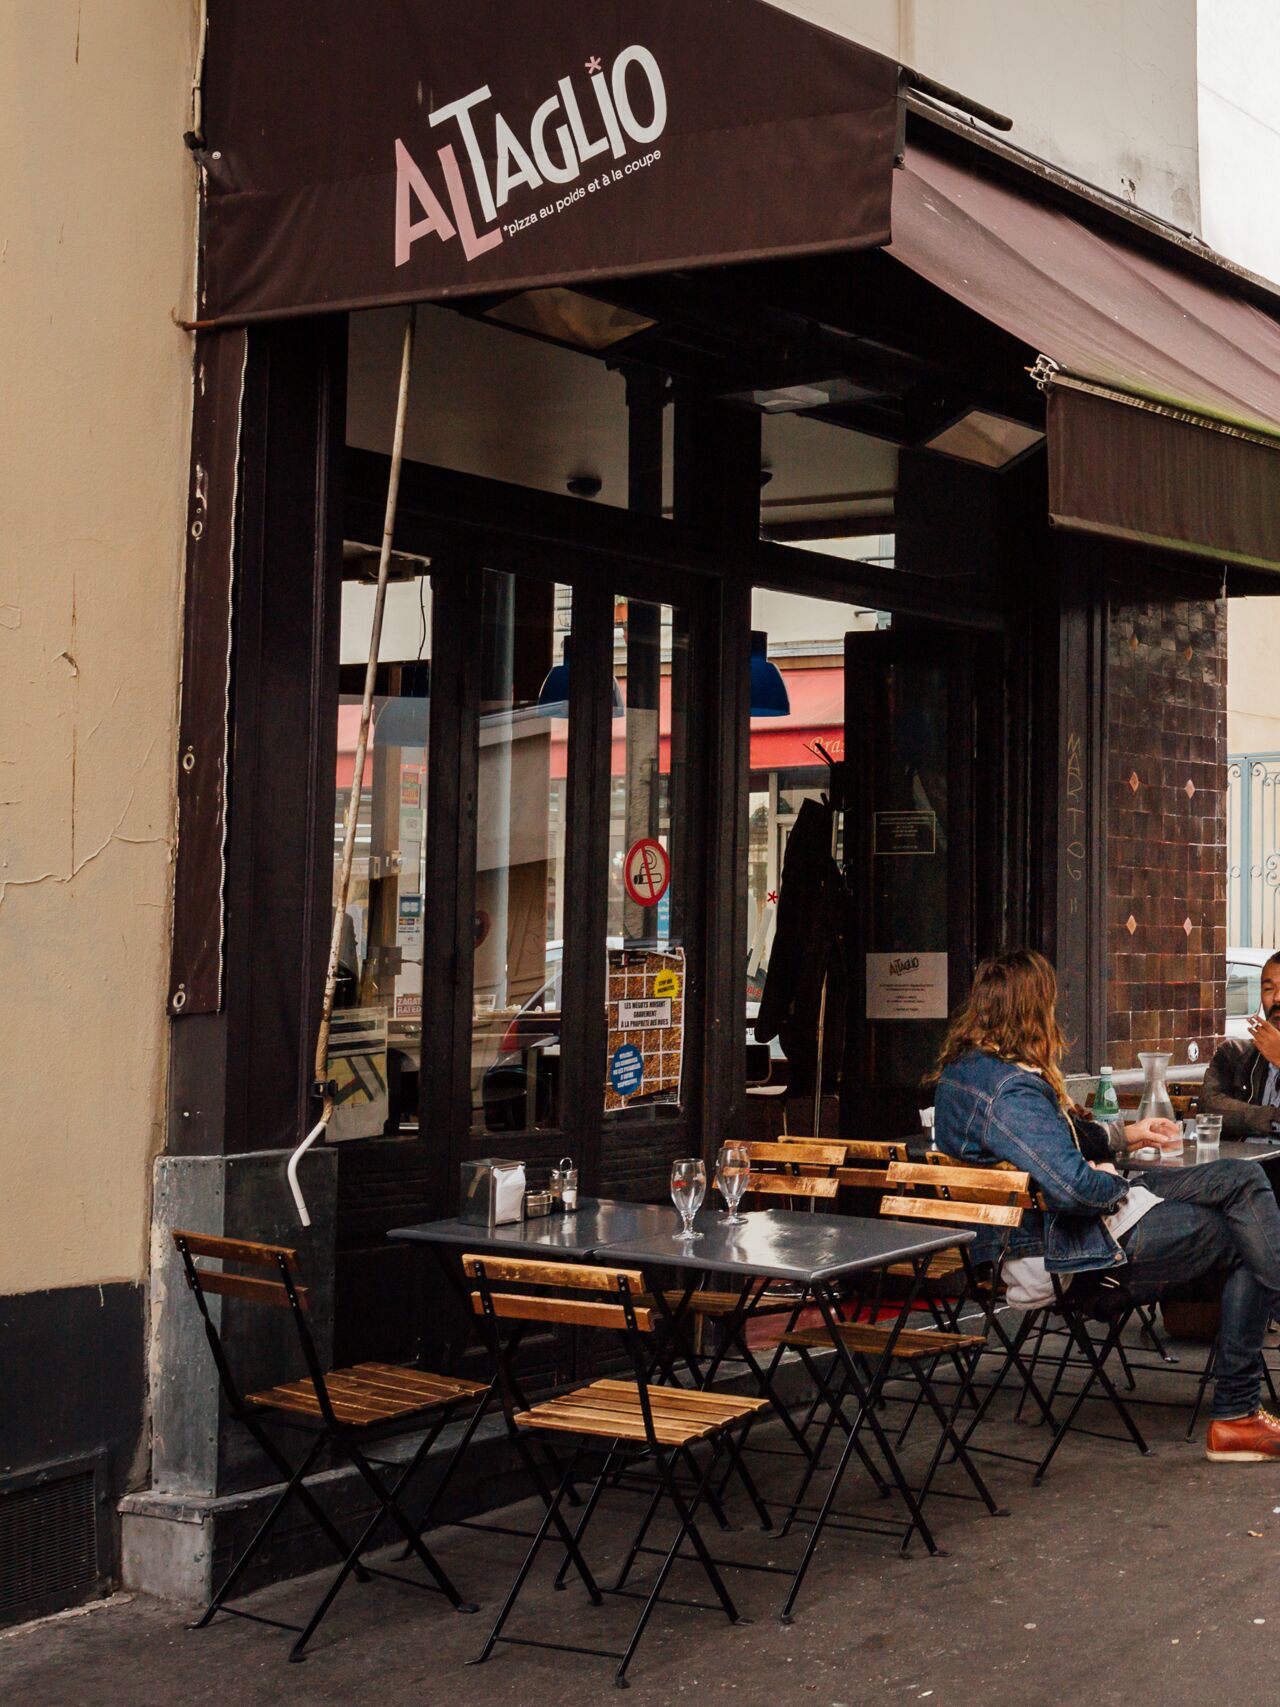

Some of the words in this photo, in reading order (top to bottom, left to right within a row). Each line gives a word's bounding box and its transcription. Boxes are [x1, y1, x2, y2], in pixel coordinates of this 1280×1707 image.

[539, 204, 555, 219] au
[555, 187, 586, 213] poids
[587, 178, 601, 193] et
[602, 173, 611, 187] à
[611, 169, 624, 182] la
[624, 149, 661, 175] coupe
[397, 1005, 422, 1014] RATED
